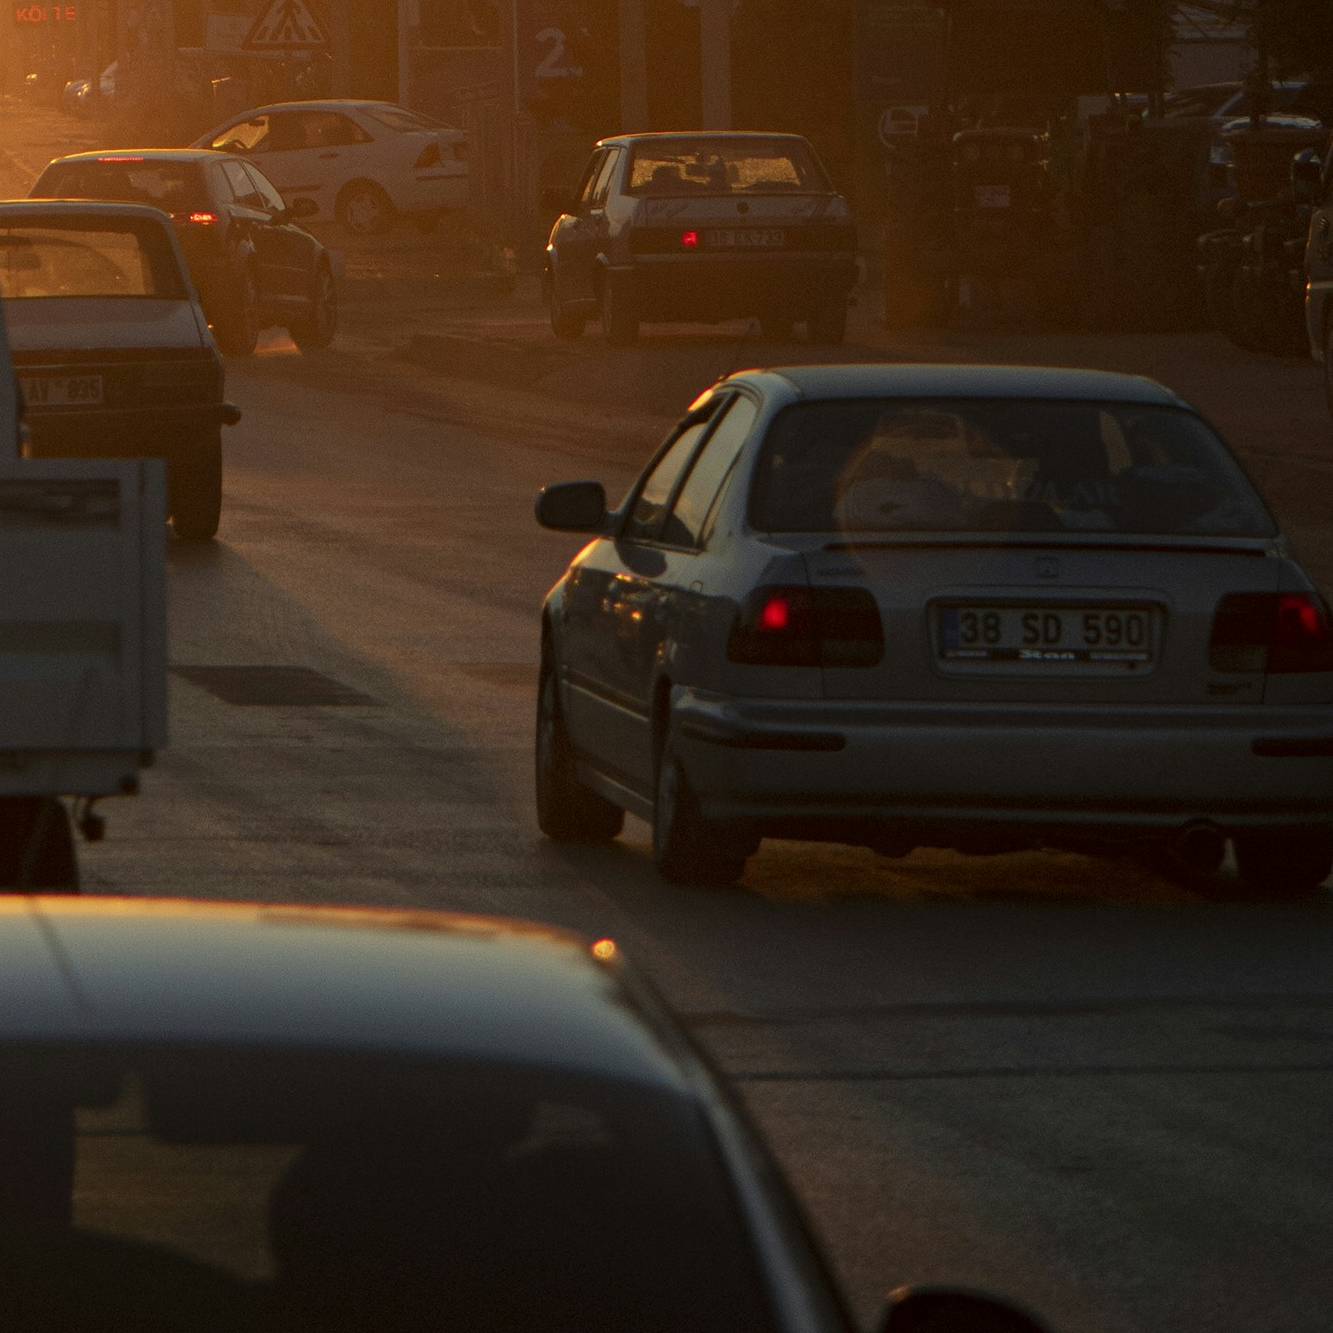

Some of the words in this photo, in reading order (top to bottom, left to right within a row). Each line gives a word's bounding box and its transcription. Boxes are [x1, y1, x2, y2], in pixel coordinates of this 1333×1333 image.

[960, 612, 1002, 644] 38
[1021, 613, 1062, 645] SD
[1083, 614, 1145, 646] 590
